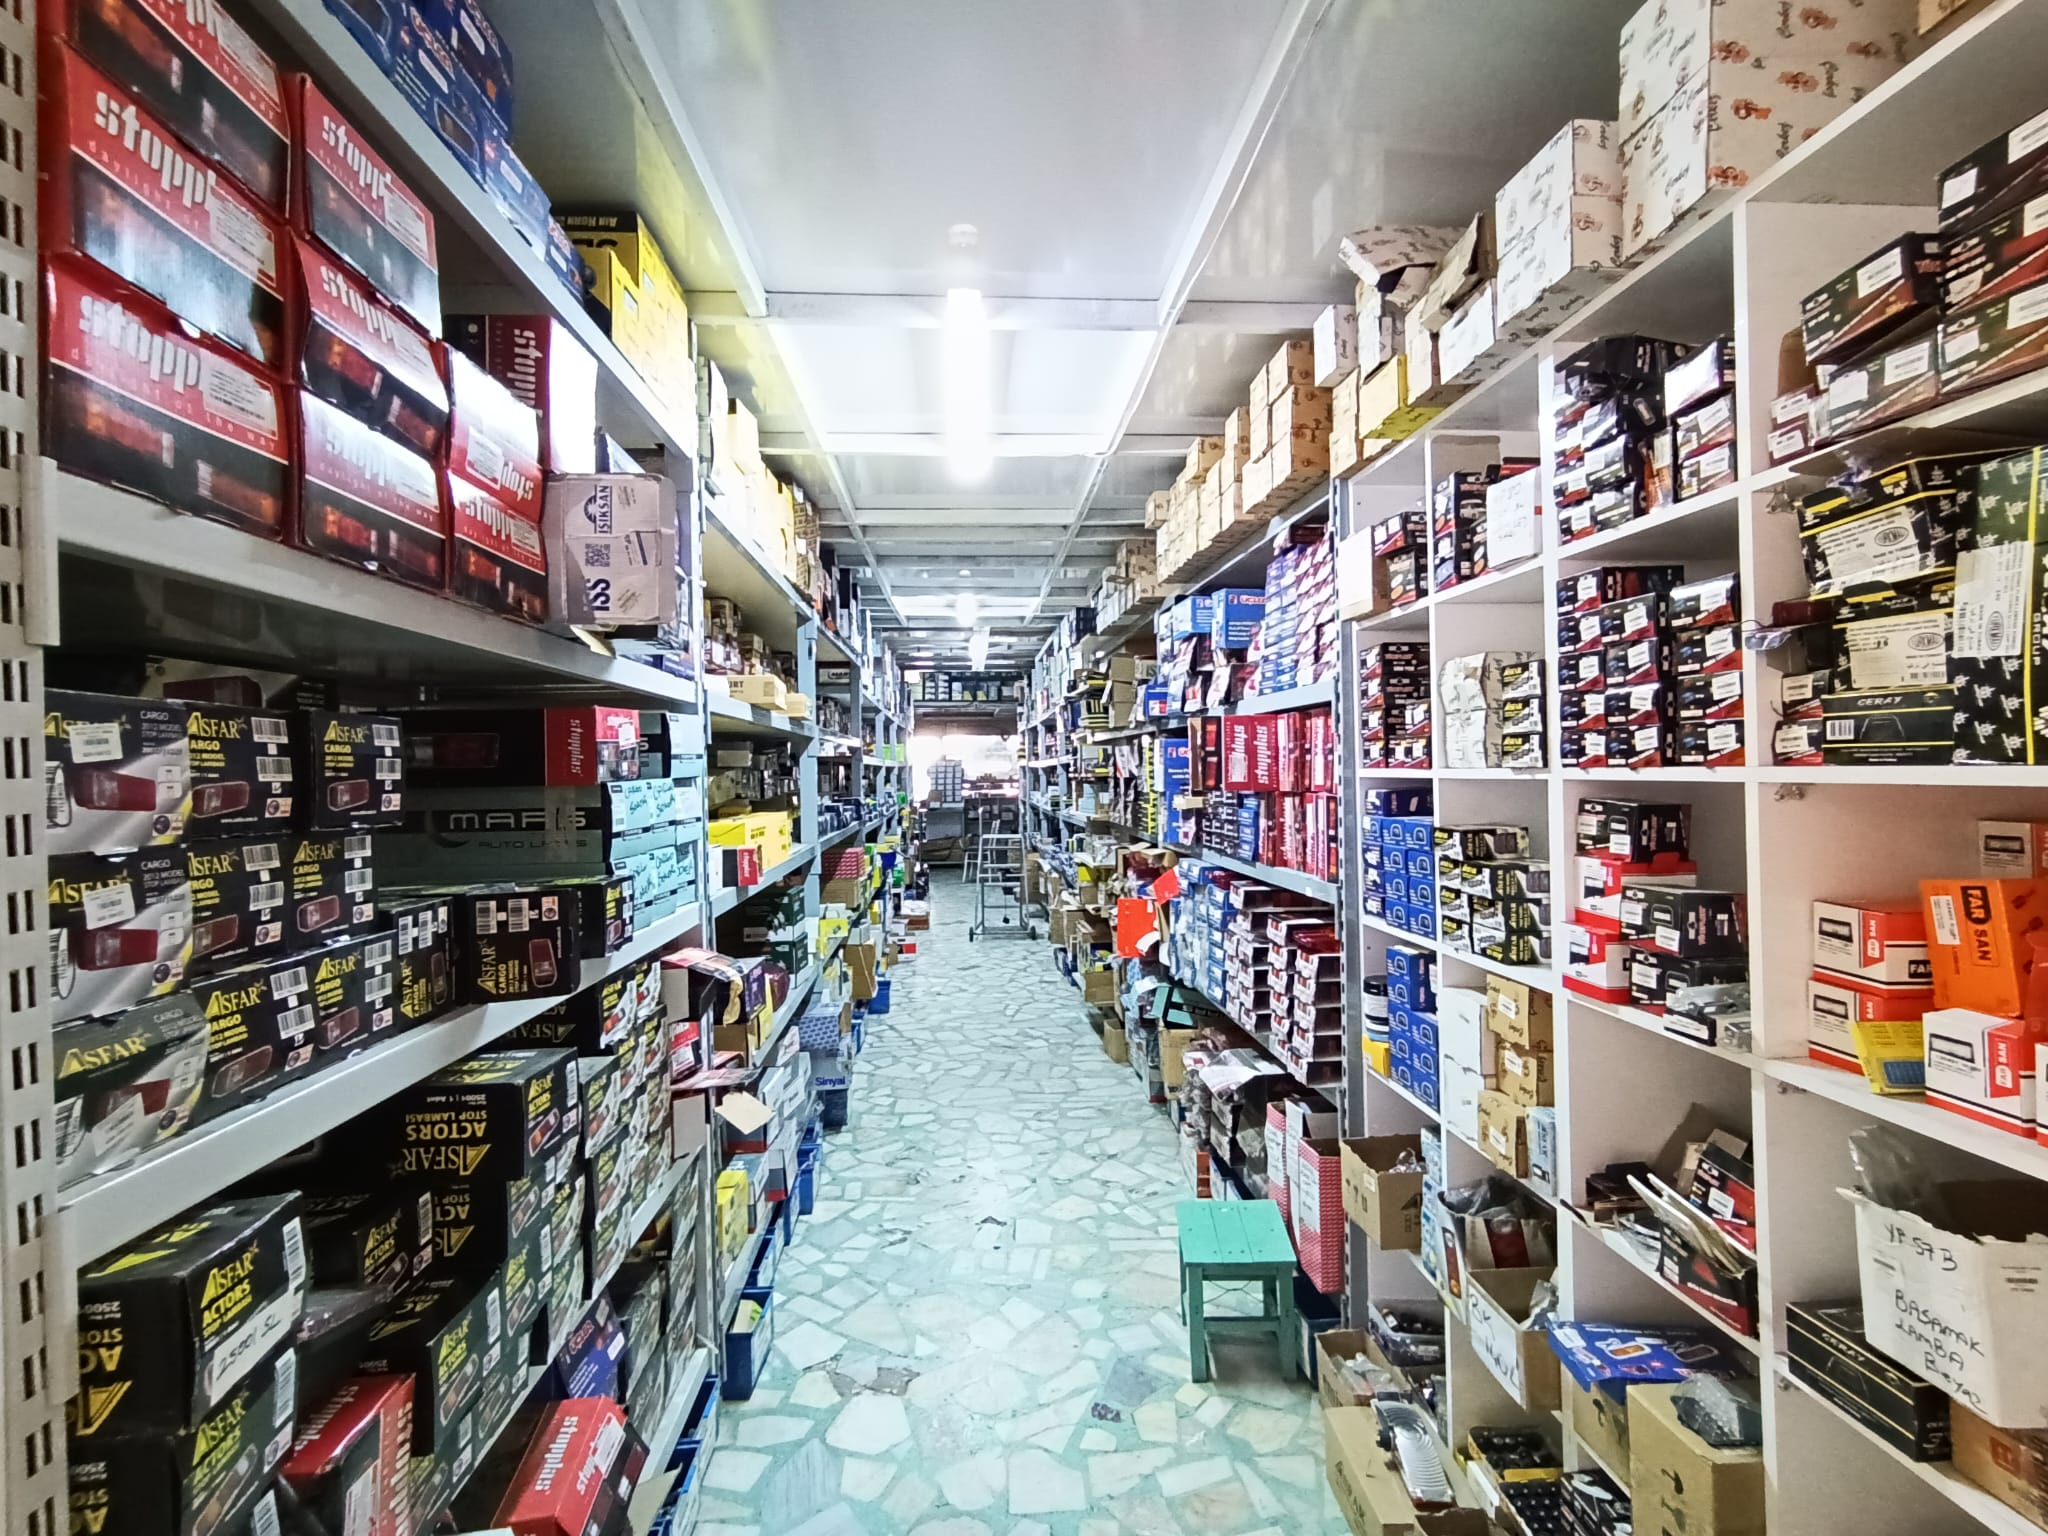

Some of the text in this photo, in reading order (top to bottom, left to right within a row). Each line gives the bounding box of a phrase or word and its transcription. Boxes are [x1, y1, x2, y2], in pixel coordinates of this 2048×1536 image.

[2032, 611, 2041, 667] GROUP
[1856, 695, 1904, 707] CERAY
[186, 711, 241, 739] ASFAR
[323, 719, 366, 744] ASFAR
[1253, 724, 1273, 785] stopplas
[292, 840, 335, 864] ASFAR
[1867, 919, 1877, 938] SAN
[1966, 888, 1993, 962] FAR SAN
[314, 957, 357, 983] ASFAR
[477, 943, 497, 995] ASFAR
[498, 963, 507, 995] CARGO
[204, 990, 261, 1020] ASFAR
[1866, 1001, 1875, 1020] SAN
[57, 1036, 146, 1080] ASFAR
[1997, 1042, 2008, 1062] SAN
[405, 1109, 488, 1123] STOP LAMBASI
[406, 1121, 488, 1141] ACTORS
[402, 1142, 492, 1177] ASFAR
[201, 1253, 254, 1309] ASFAR
[202, 1279, 252, 1328] ACTORS
[1895, 1288, 1985, 1357] BASAMAK
[193, 1397, 247, 1467] ASFAR
